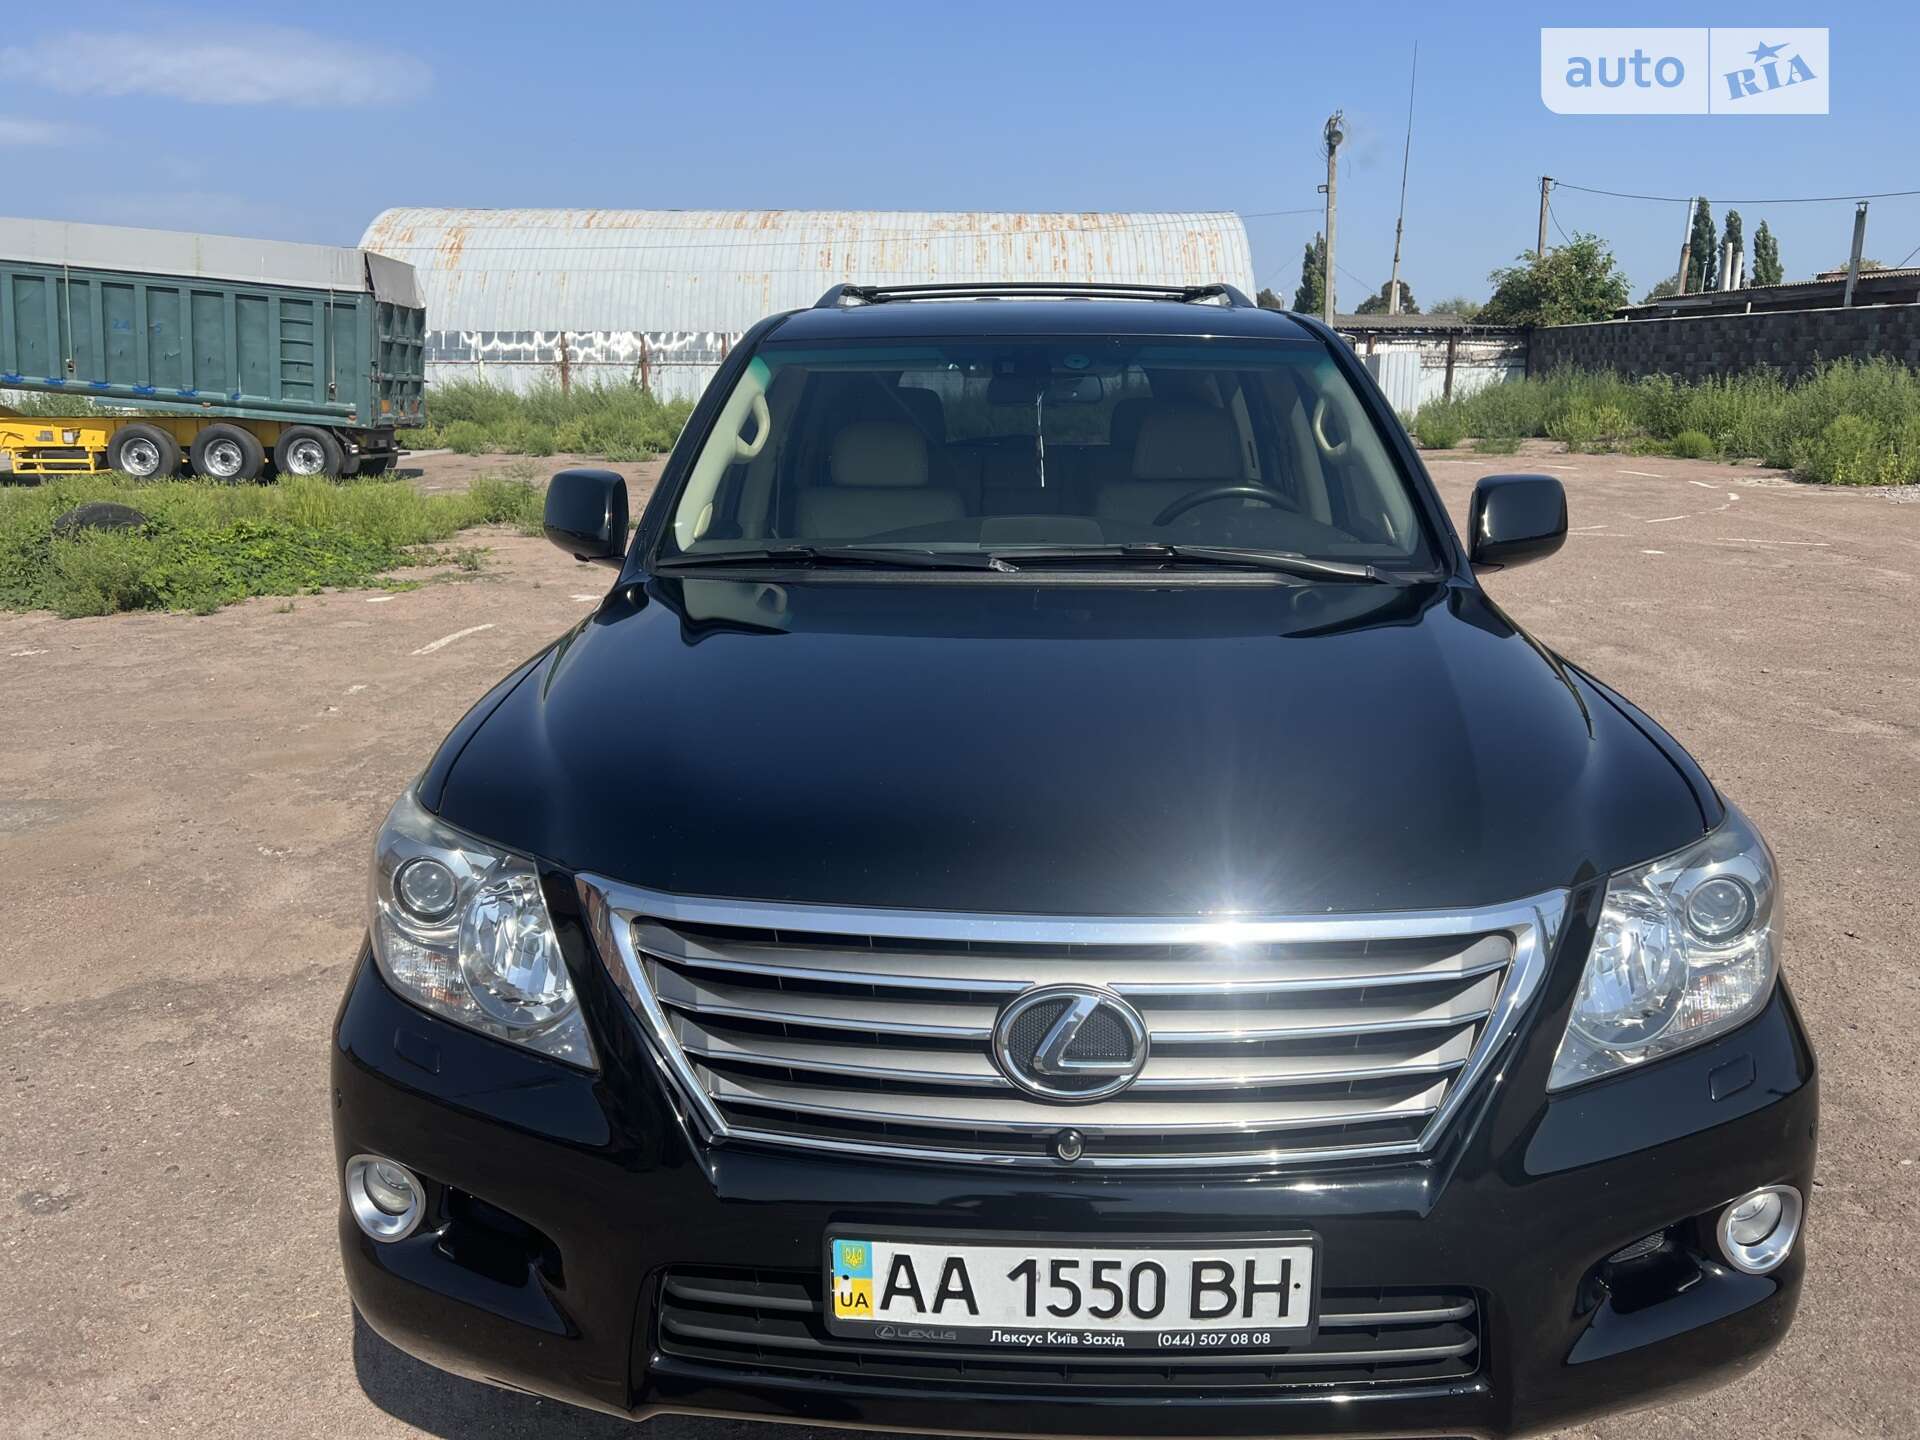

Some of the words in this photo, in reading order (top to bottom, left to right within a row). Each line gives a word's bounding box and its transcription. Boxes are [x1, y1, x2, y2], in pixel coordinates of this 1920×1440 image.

[880, 1254, 979, 1315] AA
[1007, 1258, 1166, 1319] 1550
[1190, 1258, 1291, 1319] BH
[840, 1292, 869, 1308] UA
[897, 1327, 957, 1341] LEXUS
[990, 1330, 1043, 1347] Лексус
[1047, 1331, 1079, 1345] Київ
[1082, 1332, 1125, 1347] Захід
[1157, 1332, 1195, 1347] (044)
[1199, 1333, 1226, 1345] 507
[1230, 1333, 1249, 1345] 08
[1252, 1332, 1271, 1345] 08
